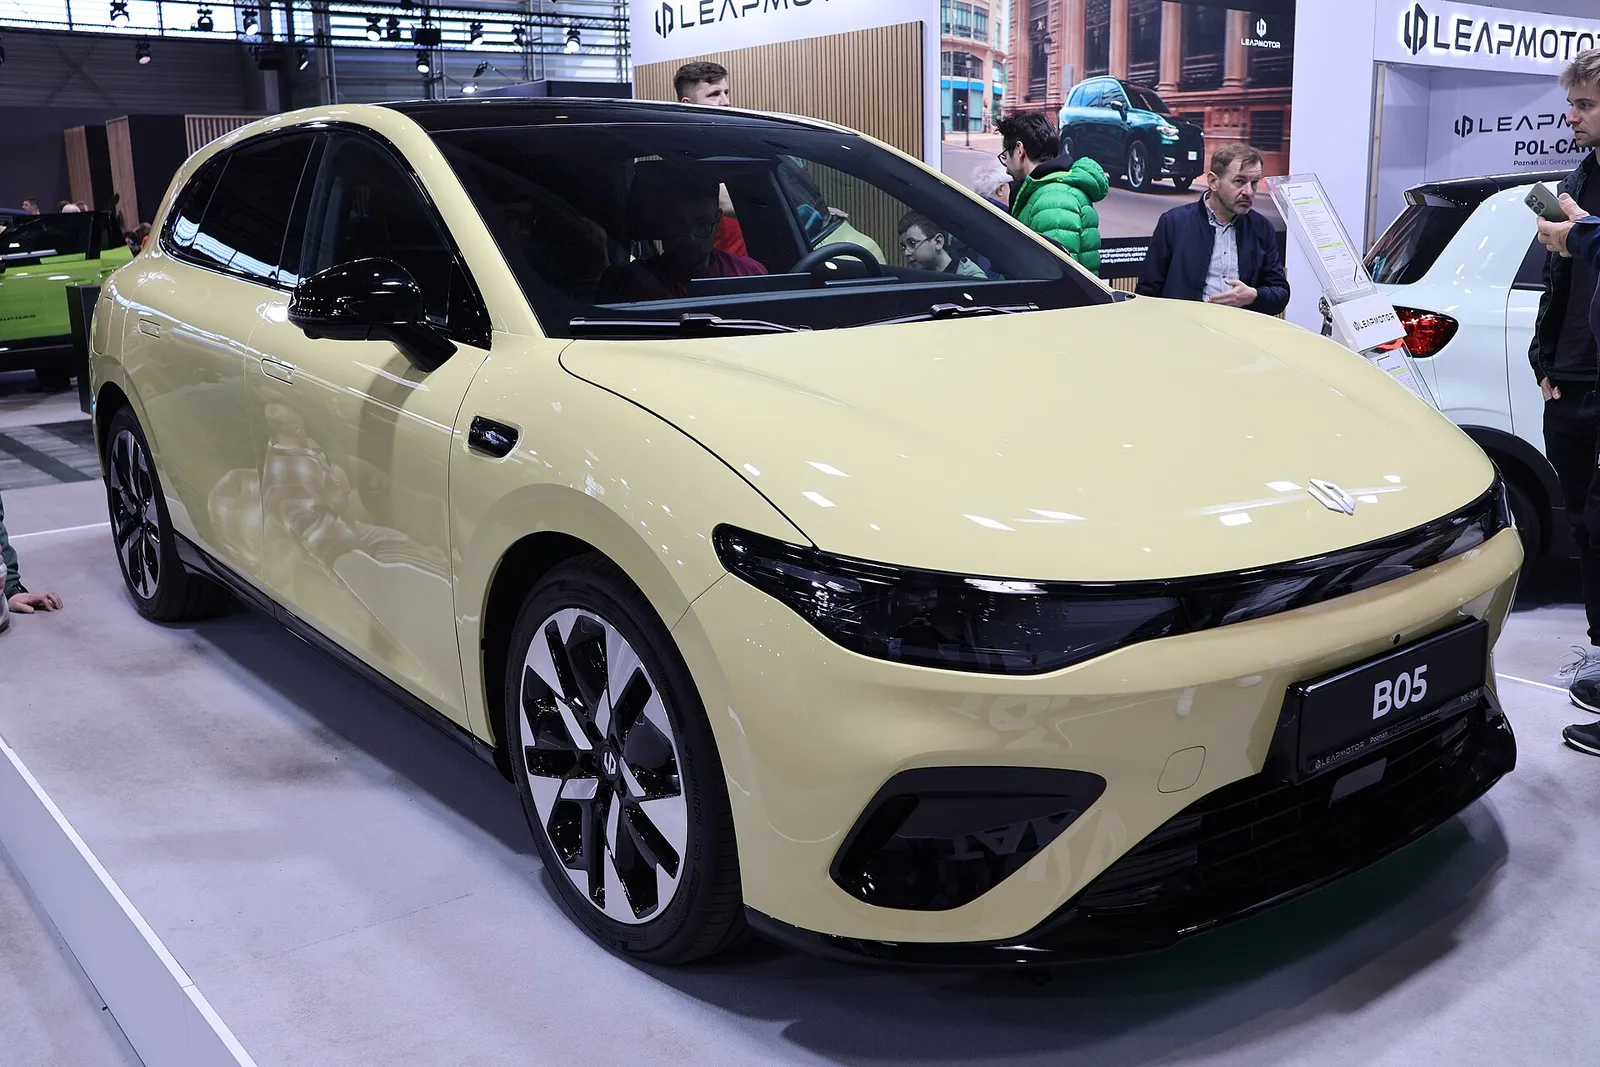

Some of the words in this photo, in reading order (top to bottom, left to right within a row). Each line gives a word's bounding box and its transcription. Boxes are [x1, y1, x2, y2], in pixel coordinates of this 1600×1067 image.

[681, 0, 811, 29] LEAPM
[1240, 38, 1281, 49] LEAPMOTOR
[1433, 15, 1600, 60] LEAPMOTO
[1478, 113, 1572, 133] LEAPM
[1513, 159, 1539, 167] Poznań
[1549, 157, 1583, 168] Gorzysław
[1359, 312, 1396, 330] LEAPMOTOR
[1372, 664, 1428, 720] B05
[1321, 741, 1365, 766] LEAPMOTOR
